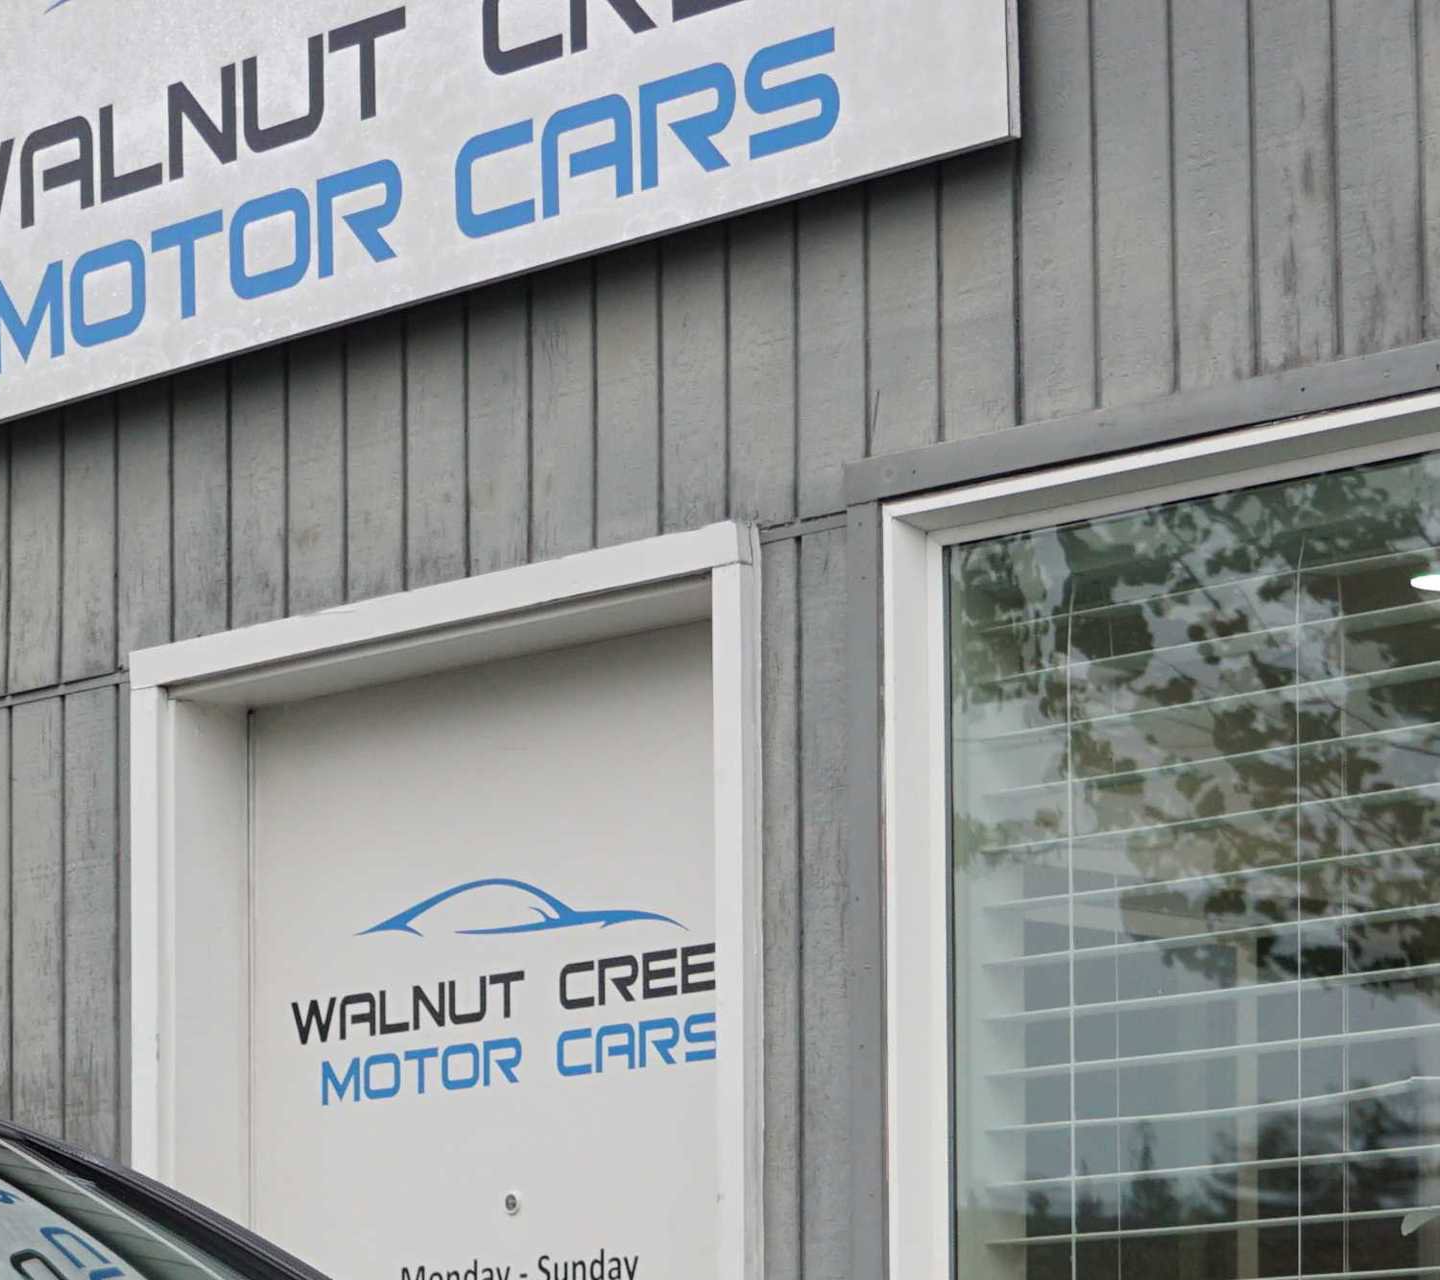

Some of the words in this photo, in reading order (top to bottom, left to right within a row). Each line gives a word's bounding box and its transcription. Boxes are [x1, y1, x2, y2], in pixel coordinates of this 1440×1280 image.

[455, 27, 841, 241] CARS
[291, 970, 525, 1046] WALNUT
[321, 1037, 522, 1106] MOTOR
[556, 1012, 717, 1077] CARS
